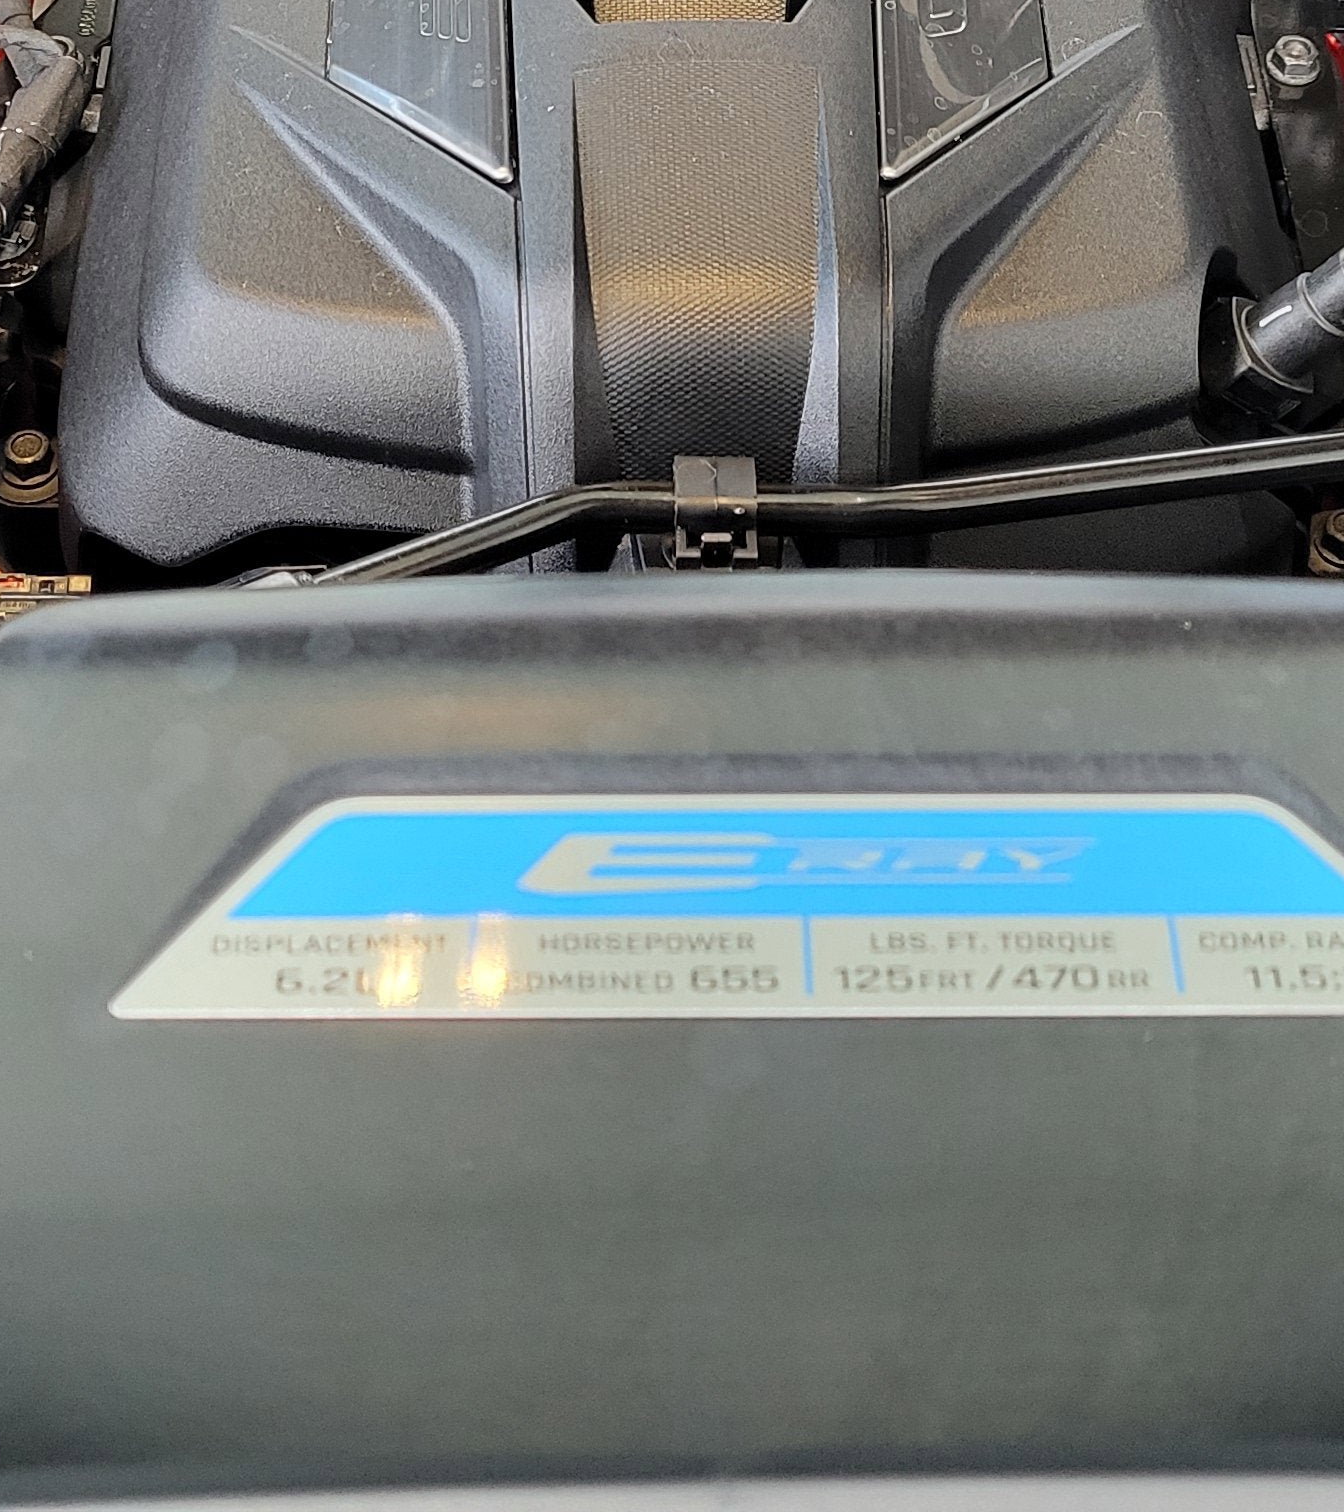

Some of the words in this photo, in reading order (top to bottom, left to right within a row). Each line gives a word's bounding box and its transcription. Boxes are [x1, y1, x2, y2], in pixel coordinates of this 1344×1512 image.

[211, 931, 447, 954] DISPLACEMENT
[538, 931, 757, 954] HORSEPOWER
[870, 930, 929, 954] LBS.
[946, 930, 989, 954] FT.
[1000, 930, 1117, 955] TORQUE
[1198, 930, 1301, 954] COMP.
[691, 965, 781, 994] 655
